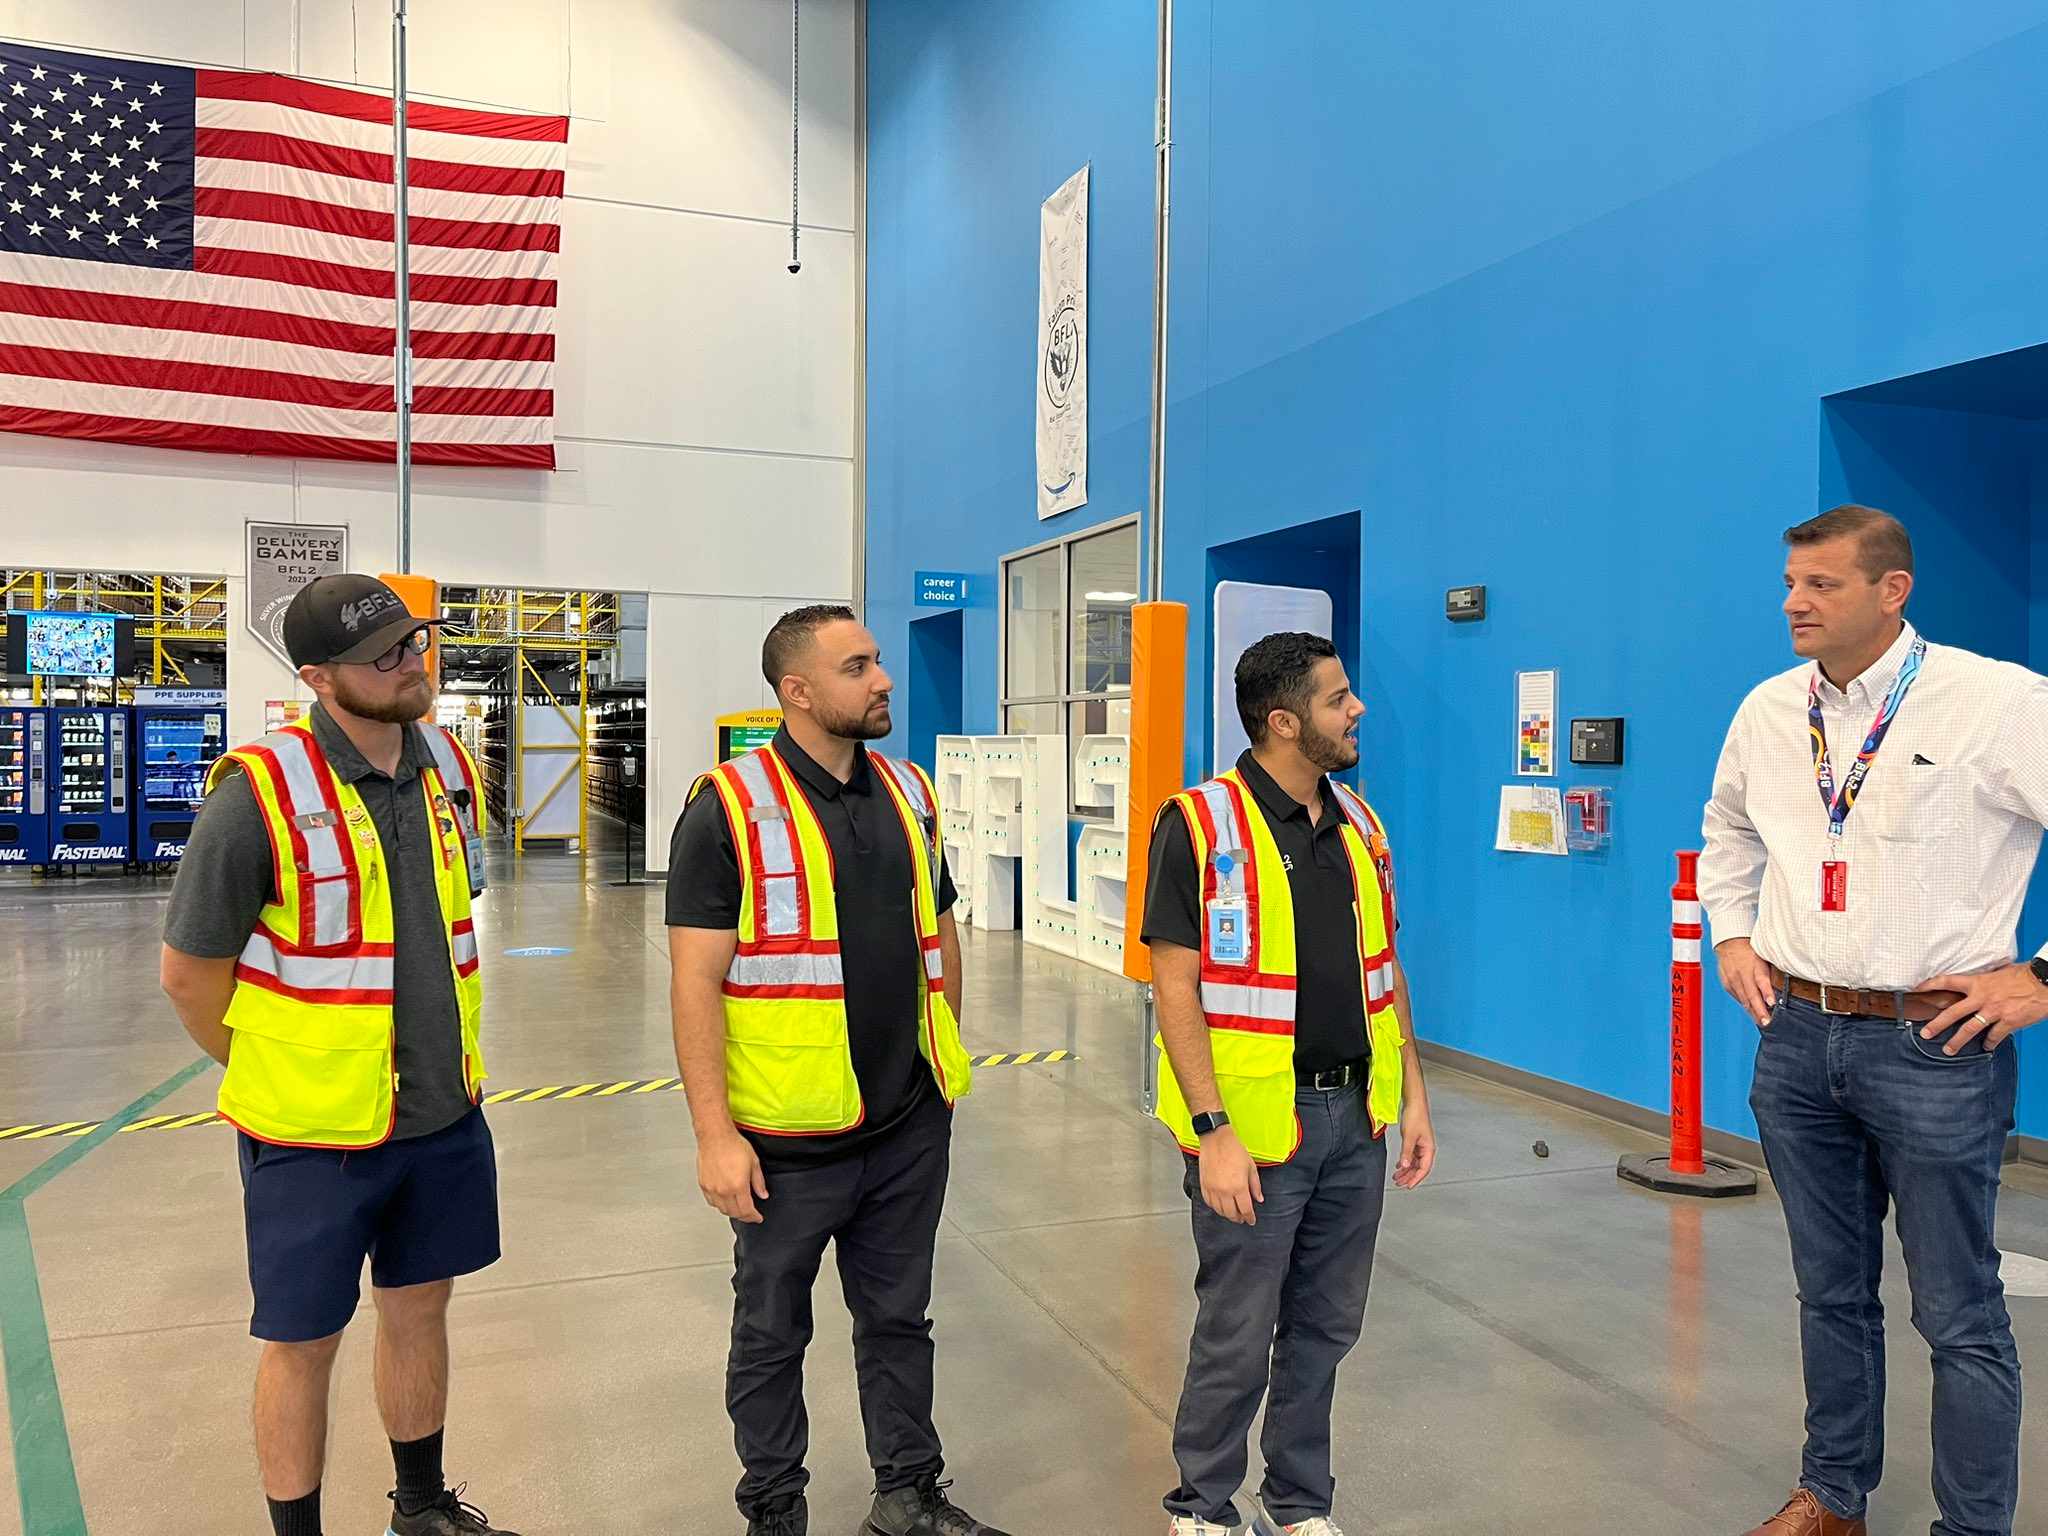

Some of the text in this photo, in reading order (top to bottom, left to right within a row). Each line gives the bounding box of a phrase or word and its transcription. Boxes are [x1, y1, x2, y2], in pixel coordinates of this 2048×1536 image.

[257, 537, 340, 549] DELIVERY
[256, 548, 339, 562] GAMES
[278, 565, 317, 575] BFL2
[287, 575, 307, 583] 2023
[923, 578, 955, 588] career
[923, 590, 955, 601] choice
[259, 601, 277, 621] SILVER
[176, 691, 223, 699] SUPPLIES
[1846, 762, 1866, 790] BFL2
[0, 849, 26, 860] NAL
[52, 844, 126, 860] FASTENAL
[155, 843, 186, 857] FAS
